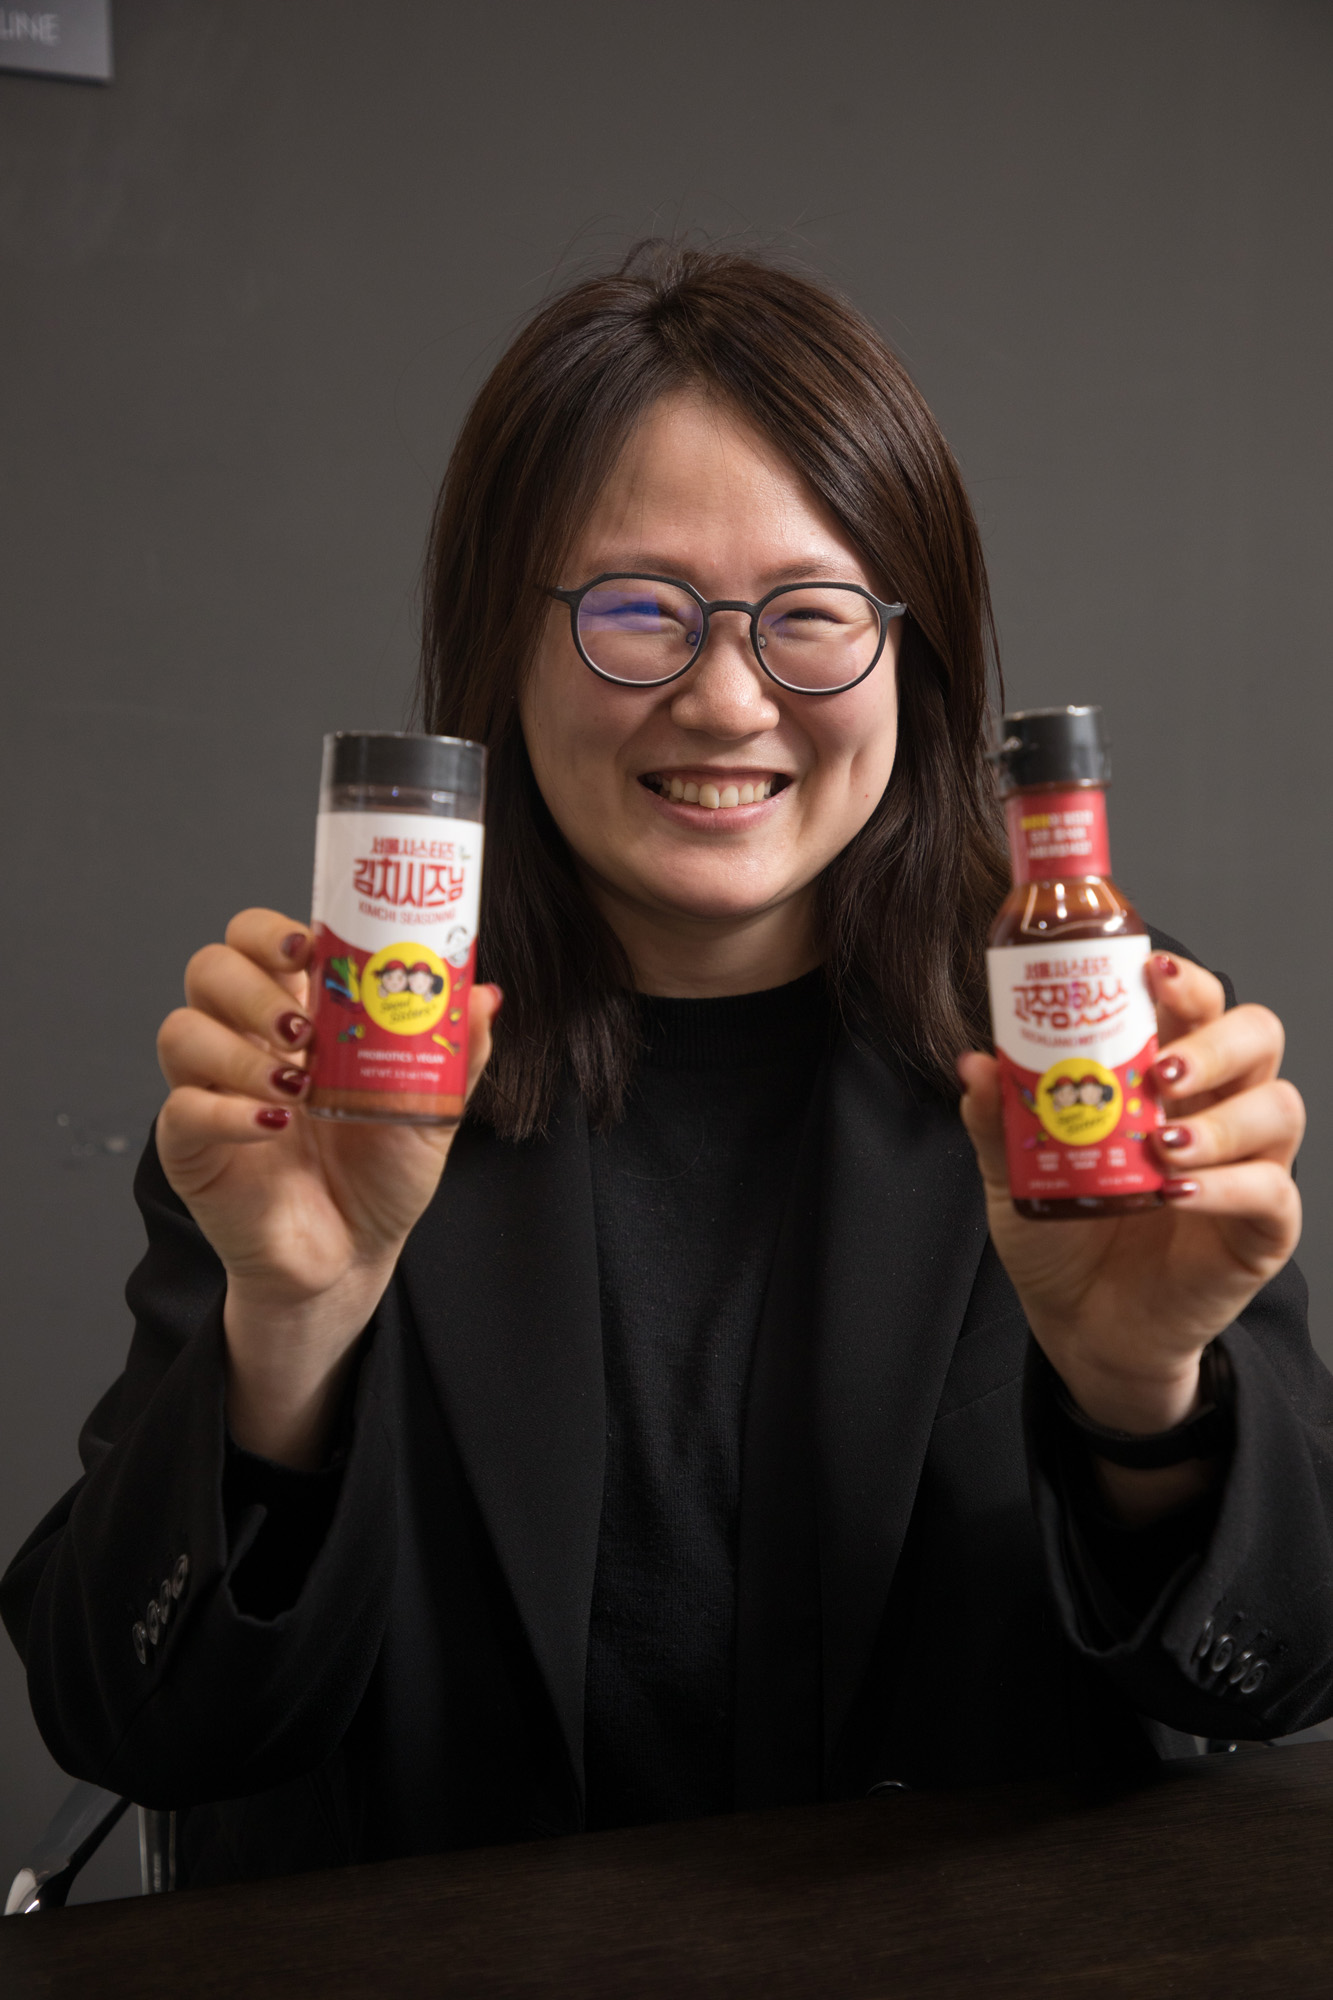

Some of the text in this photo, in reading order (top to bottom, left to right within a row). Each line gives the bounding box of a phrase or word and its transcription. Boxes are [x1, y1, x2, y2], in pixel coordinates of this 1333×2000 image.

[370, 837, 455, 860] 서울시스터즈
[353, 857, 464, 908] 김치시즈닝
[358, 900, 456, 925] KIMCHI SEASONING
[416, 1052, 445, 1064] VEGAN
